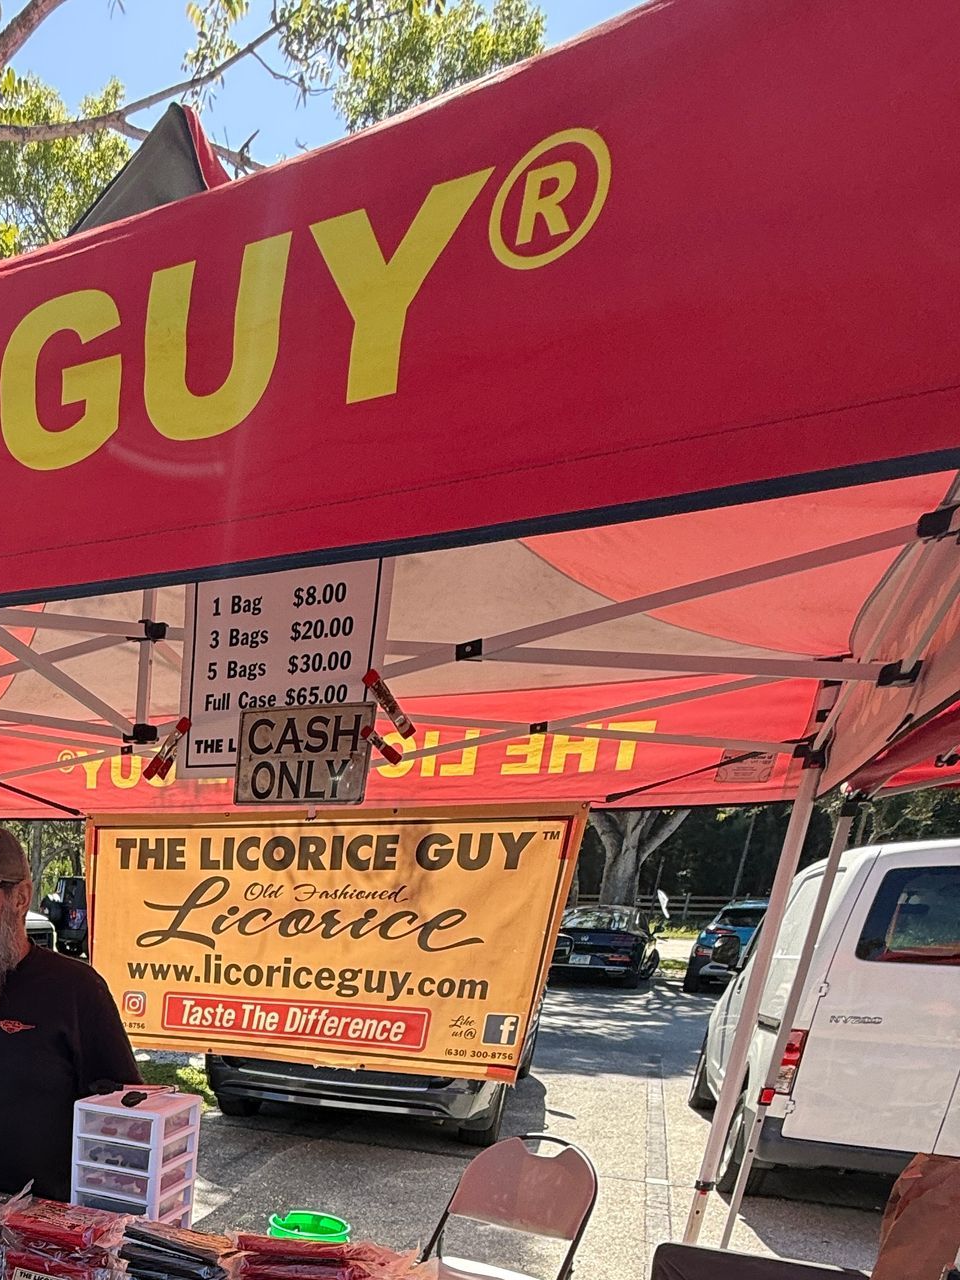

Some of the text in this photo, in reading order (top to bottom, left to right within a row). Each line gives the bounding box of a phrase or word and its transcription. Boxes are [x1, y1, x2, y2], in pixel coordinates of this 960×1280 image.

[212, 582, 347, 616] 1 Bag $8.00
[209, 616, 354, 649] 3 Bags $20.00
[207, 650, 352, 681] 5 Bags $30.00
[205, 684, 348, 712] Full Case $65.00
[194, 739, 224, 754] THE
[248, 714, 363, 755] CASH
[250, 758, 352, 800] ONLY
[115, 837, 186, 870] THE
[200, 834, 400, 871] LICORICE
[244, 882, 409, 904] Old Fashioned
[136, 875, 484, 952] Licorice
[127, 954, 489, 1001] www.licoriceguy.com
[181, 1000, 406, 1042] Taste The Difference
[449, 1015, 475, 1029] Like
[444, 1047, 514, 1060] (630) 300-8756
